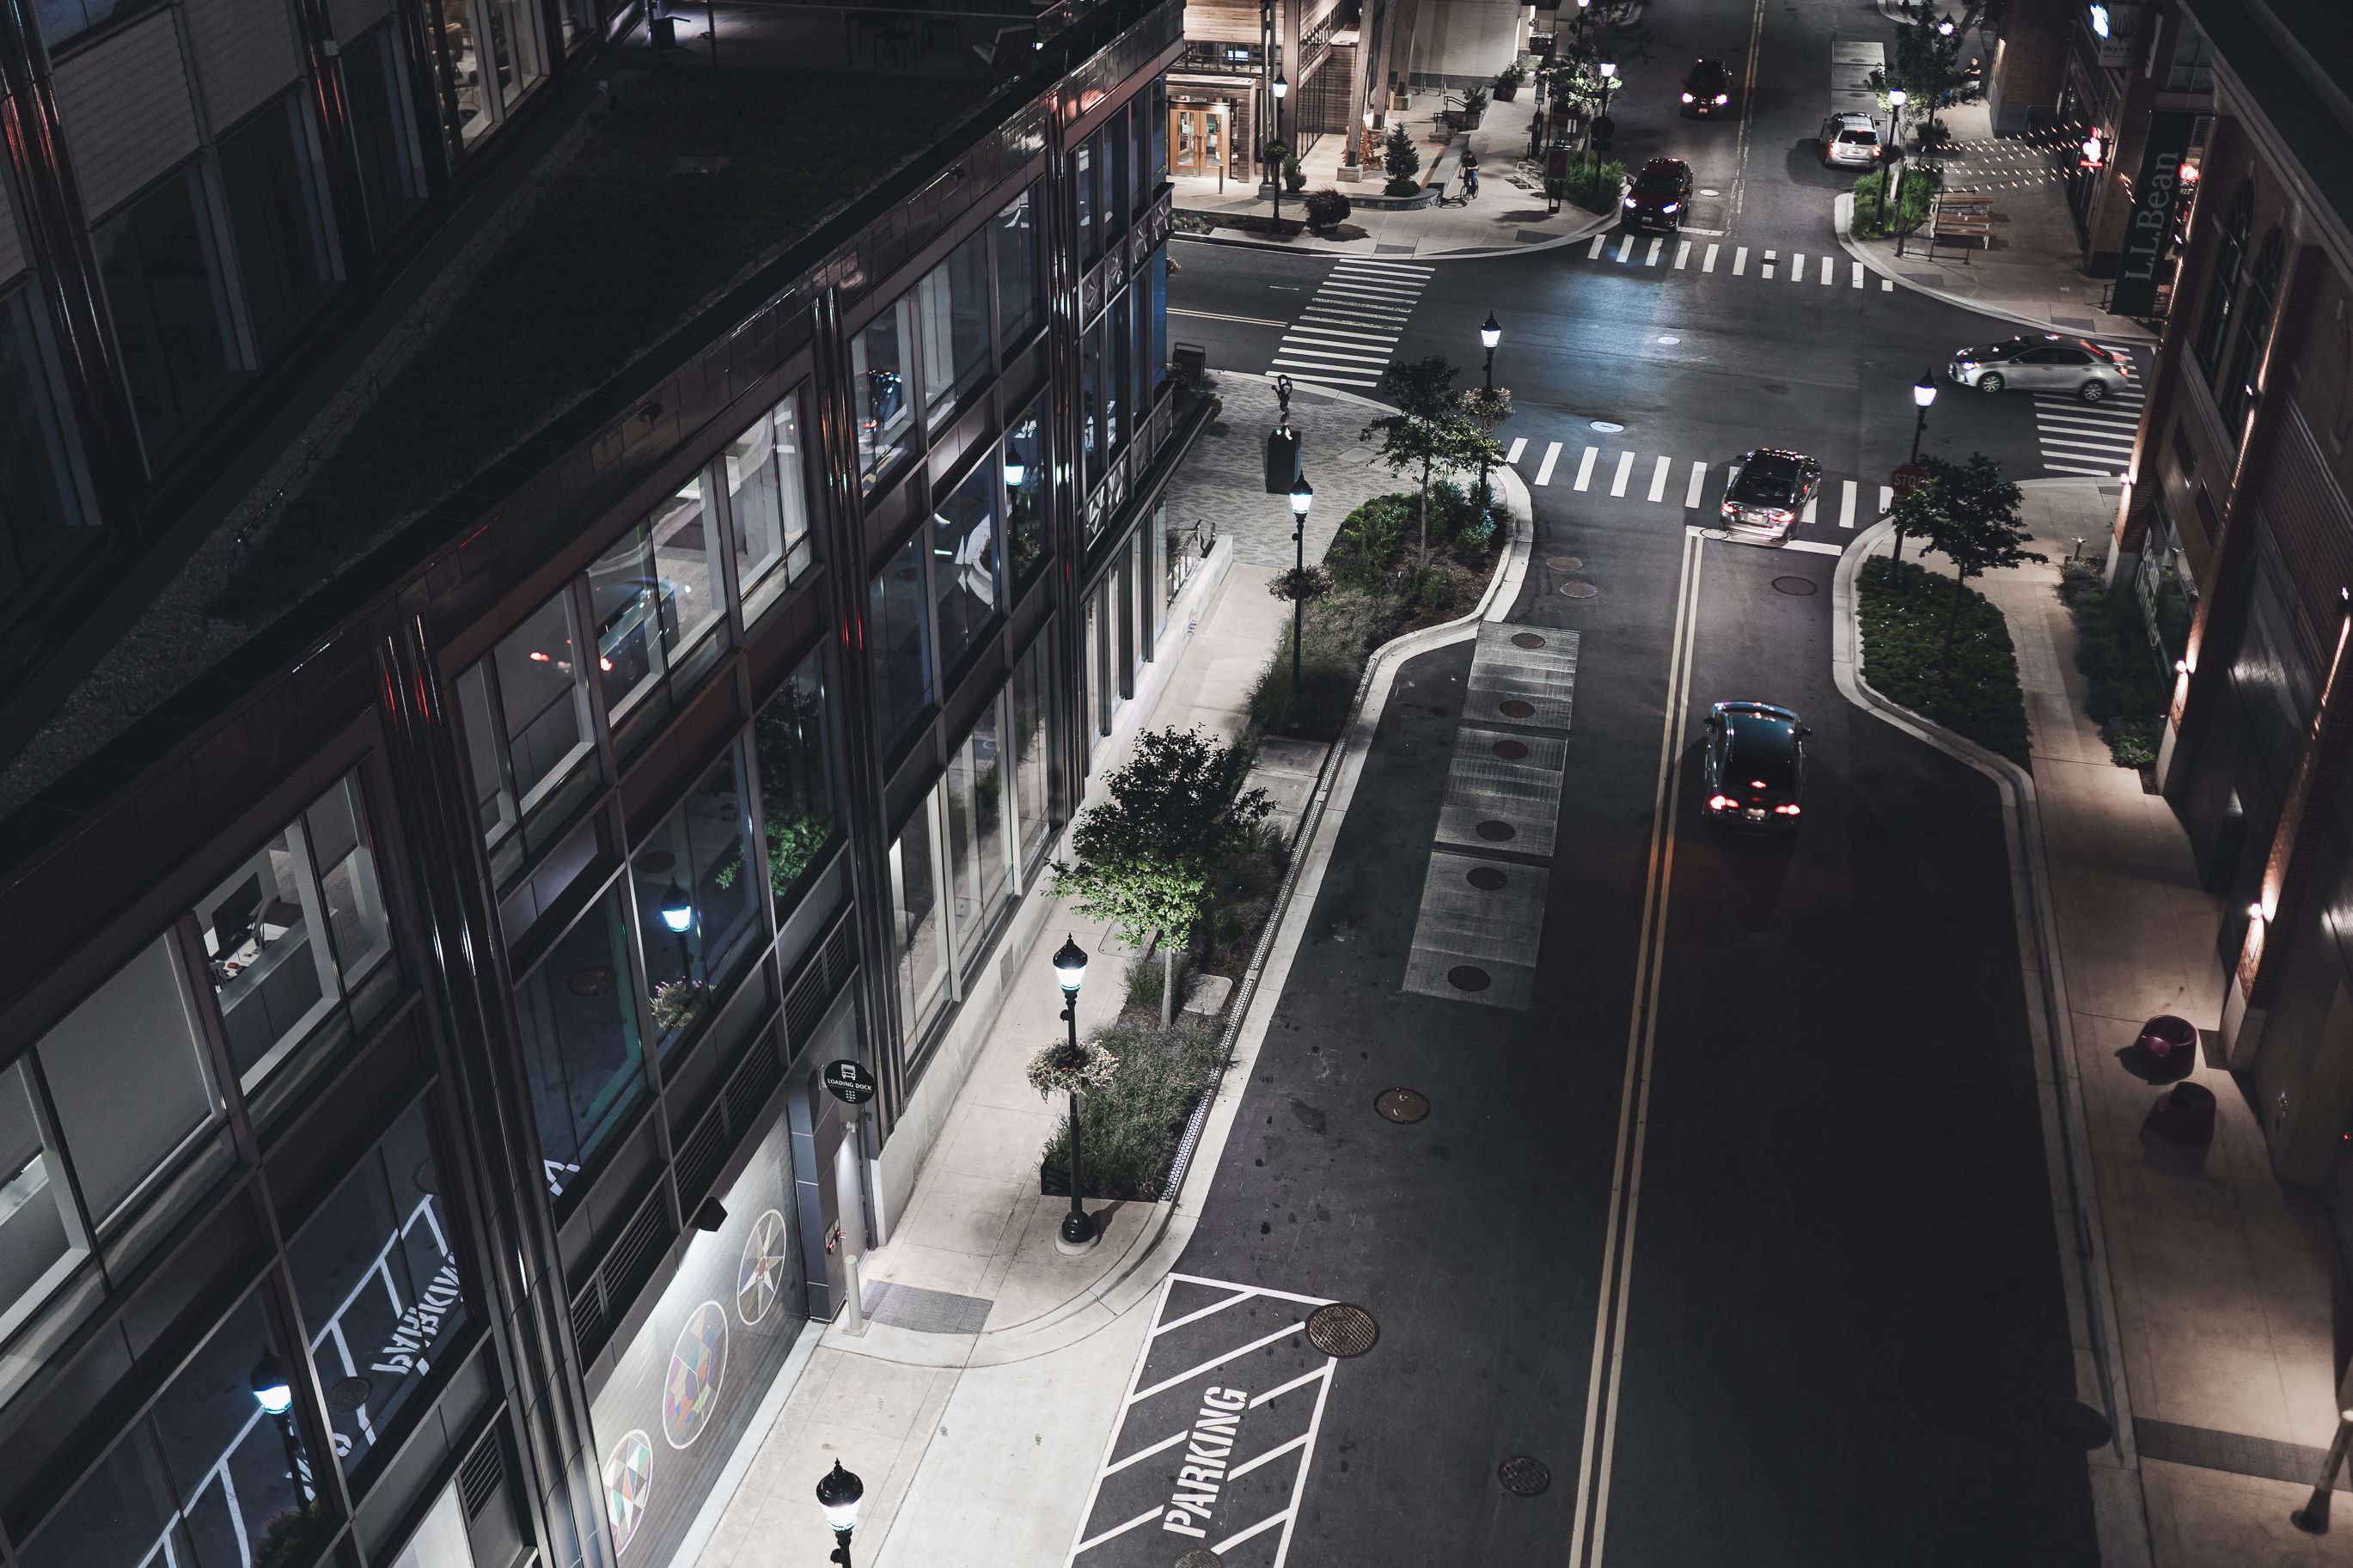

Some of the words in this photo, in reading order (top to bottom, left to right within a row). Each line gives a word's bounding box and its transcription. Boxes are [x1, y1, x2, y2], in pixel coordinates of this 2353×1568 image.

[2124, 152, 2179, 280] L.L.Bean
[828, 1078, 853, 1088] LOADING
[1163, 1386, 1248, 1539] PARKING
